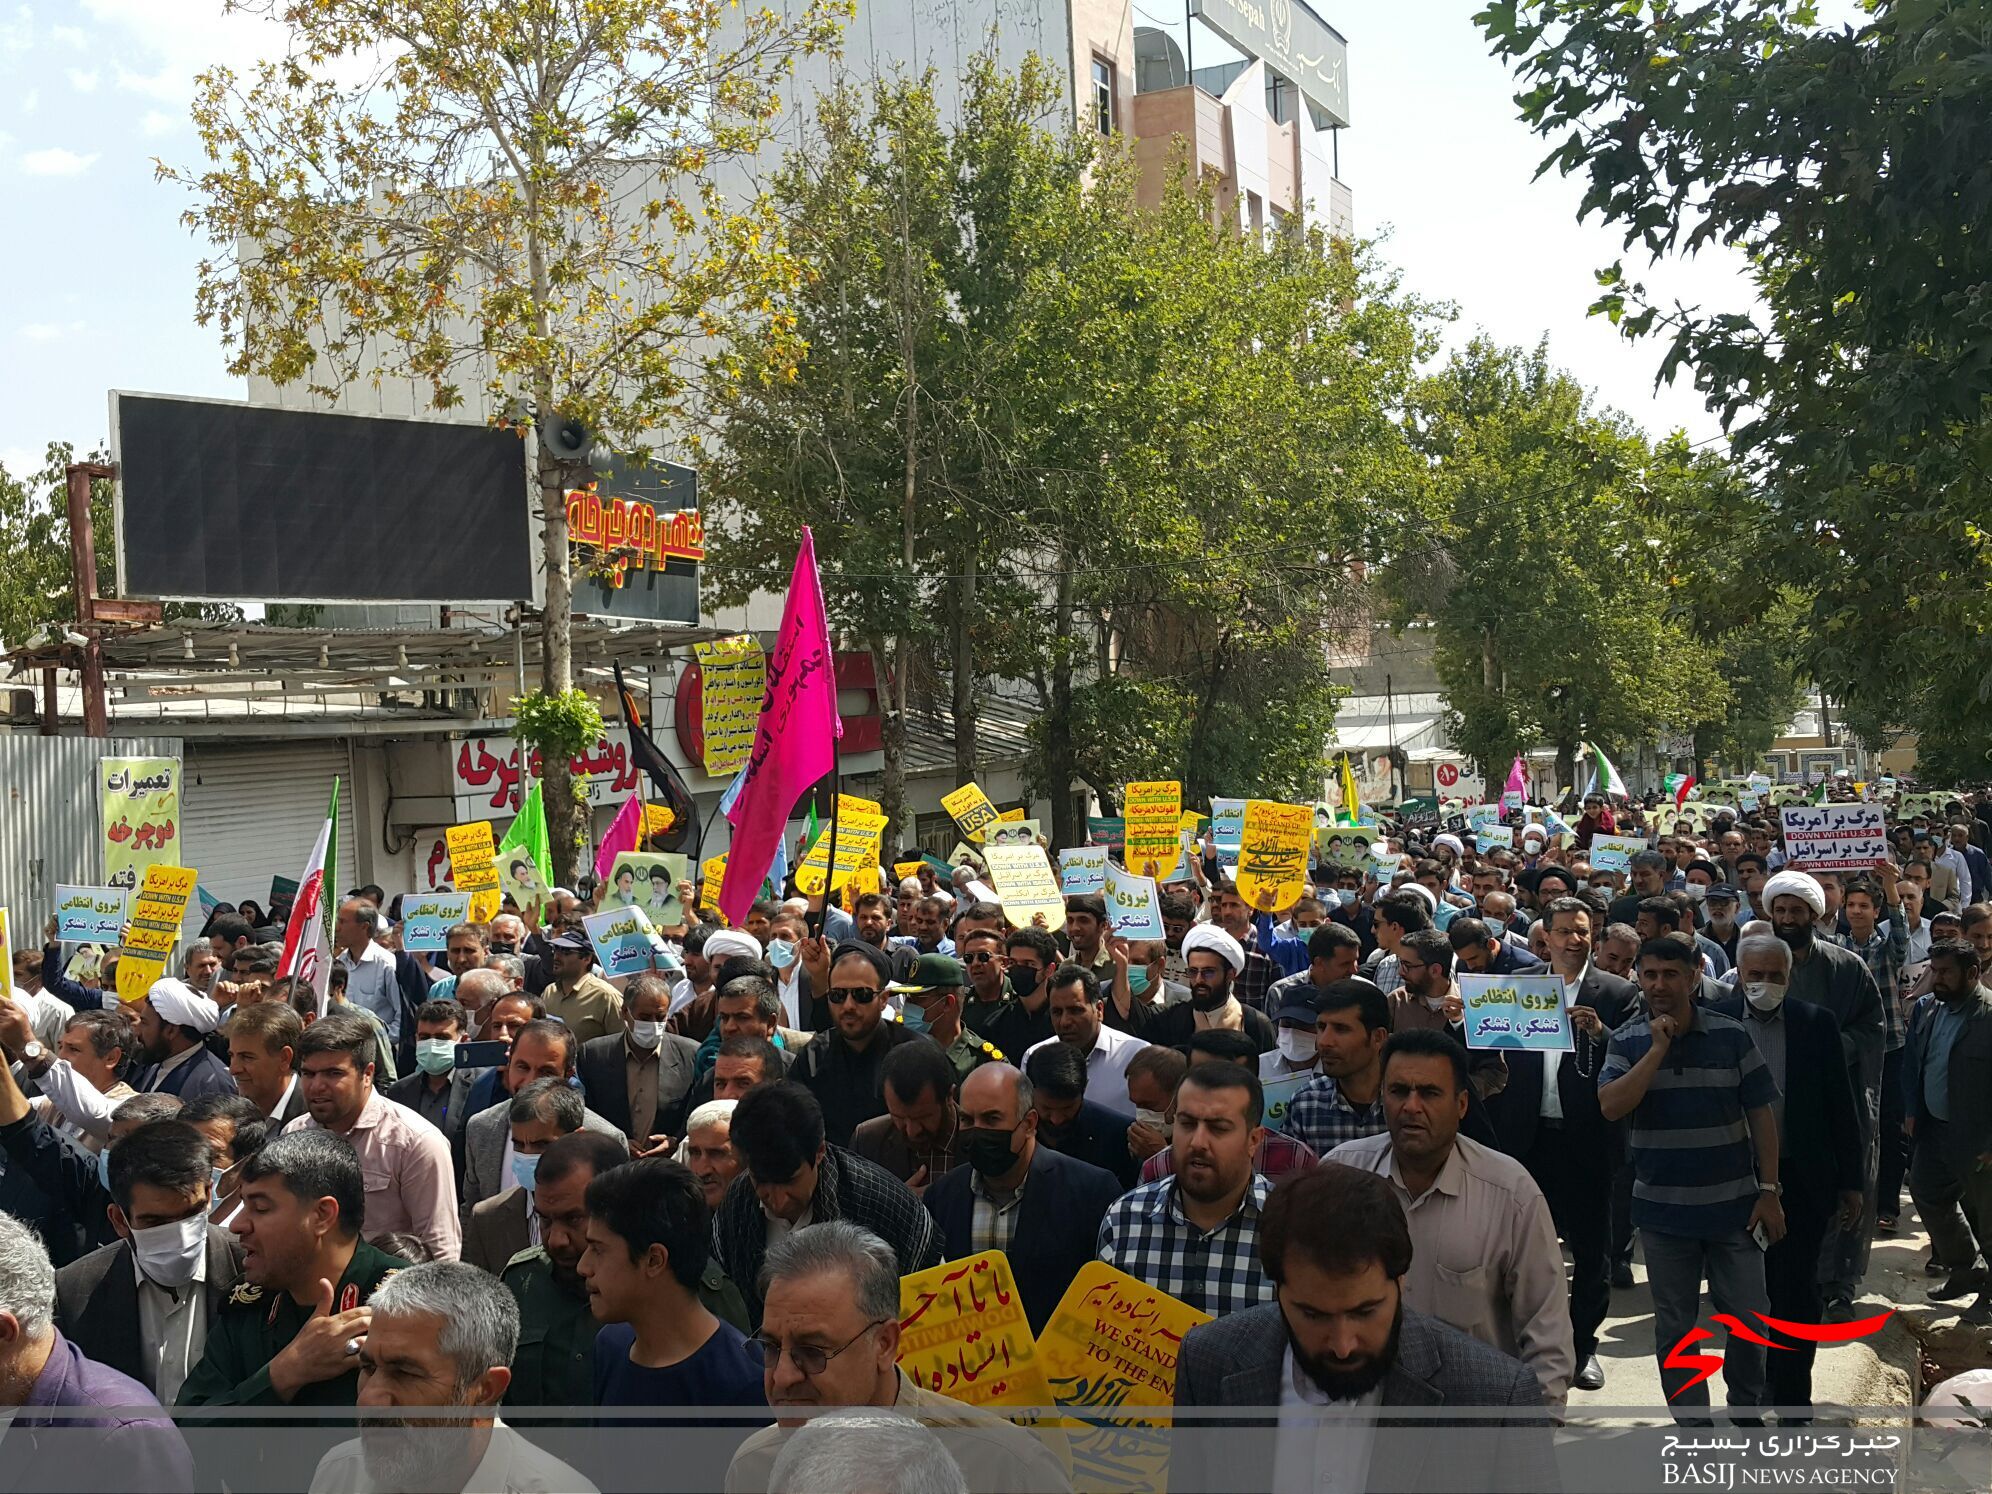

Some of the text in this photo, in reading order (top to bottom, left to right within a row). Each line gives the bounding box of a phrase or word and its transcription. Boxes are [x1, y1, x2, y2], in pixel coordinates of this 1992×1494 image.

[107, 768, 171, 798] تعمیرات
[1132, 785, 1177, 796] مرگ بر امریکا
[962, 809, 994, 831] USA
[1214, 808, 1242, 821] انتظامی
[1785, 809, 1879, 831] مرگ بر آمریکا
[864, 819, 879, 828] مرگ
[108, 815, 175, 850] دوچرخه
[451, 832, 469, 843] امریکا
[475, 829, 487, 840] مرگ
[1791, 829, 1877, 840] DOWN WITH U.S.A
[855, 838, 868, 847] مرگ
[1597, 843, 1624, 852] انتظامی
[1790, 841, 1884, 859] مرگ بر اسرائیل
[479, 852, 492, 861] مرگ
[1062, 855, 1104, 871] نیروی انتظامی
[1597, 857, 1616, 865] تشکر
[148, 873, 188, 890] مرگ بر امریکا
[1034, 870, 1048, 879] مرگ
[1066, 874, 1081, 887] تشکر
[142, 892, 157, 901] DOWN
[158, 894, 171, 902] WITH
[1041, 888, 1056, 896] مرگ
[1116, 889, 1150, 908] نیروی
[61, 896, 121, 914] نیروی انتظامی
[138, 902, 159, 917] اسرائیل
[167, 905, 180, 918] مرگ
[407, 902, 463, 919] نیروی انتظامی
[63, 918, 87, 932] تشکر
[134, 919, 175, 931] DOWN WITH ISRAEL
[1117, 915, 1150, 930] تشکر
[128, 931, 152, 947] انگلیس
[409, 925, 430, 941] تشکر
[598, 919, 637, 944] انتظامی
[158, 934, 170, 948] مرگ
[610, 945, 638, 966] تشکر
[1470, 988, 1559, 1010] نیروی انتظامی
[1475, 1018, 1510, 1036] تشکر
[969, 1259, 1011, 1313] ما تا
[1078, 1281, 1119, 1309] ایم
[1113, 1297, 1161, 1334] ایستاده
[1094, 1318, 1122, 1342] WE
[1121, 1334, 1177, 1369] STAND
[932, 1330, 1010, 1396] ایستاده
[1086, 1341, 1176, 1398] TO THE EN
[1009, 1407, 1041, 1427] UP
